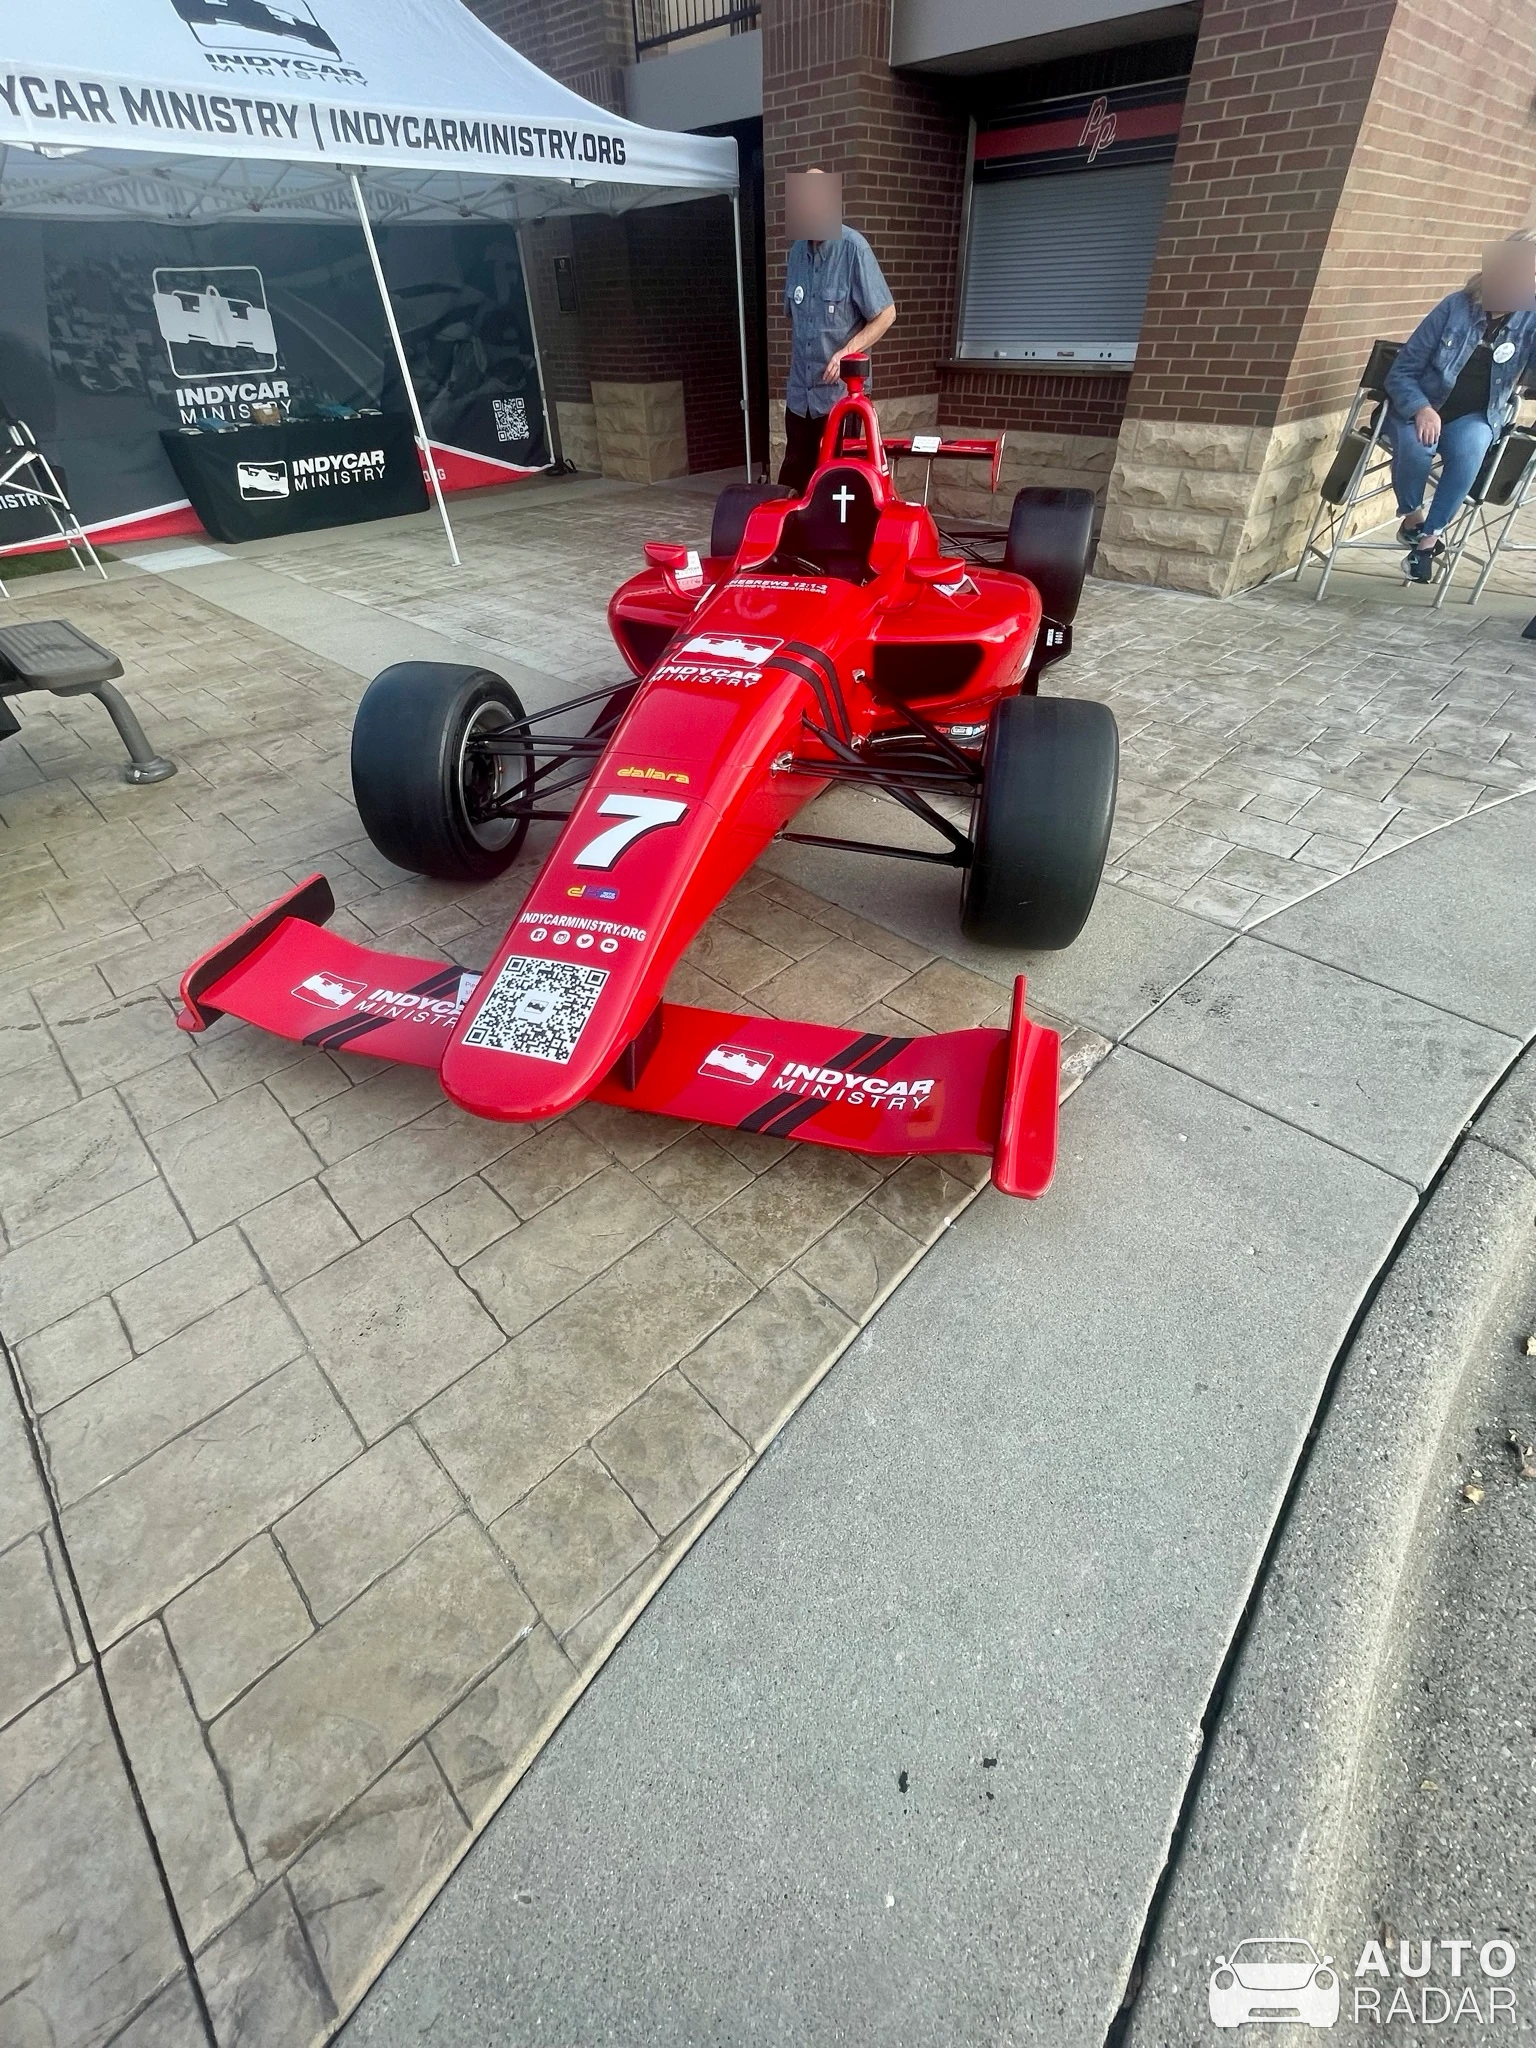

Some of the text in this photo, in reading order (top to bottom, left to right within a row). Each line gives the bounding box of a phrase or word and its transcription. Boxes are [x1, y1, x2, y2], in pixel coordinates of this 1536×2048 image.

[204, 53, 365, 80] INDYCAR
[211, 64, 368, 87] MINISTRY
[119, 86, 298, 139] MINISTRY
[330, 108, 626, 165] INDYCARMINISTRY.ORG
[175, 380, 290, 407] INDYCAR
[180, 399, 292, 425] MINISY
[292, 450, 385, 477] INDYCAR
[295, 465, 386, 491] MINISTRY
[648, 674, 758, 688] MINISTRY
[655, 666, 763, 682] INDYCAR
[617, 767, 690, 784] dallara
[573, 794, 690, 872] 7
[520, 912, 647, 942] INDYCARMINISTRY.ORG
[781, 1062, 936, 1096] INDYCAR
[771, 1076, 929, 1110] MINISTRY
